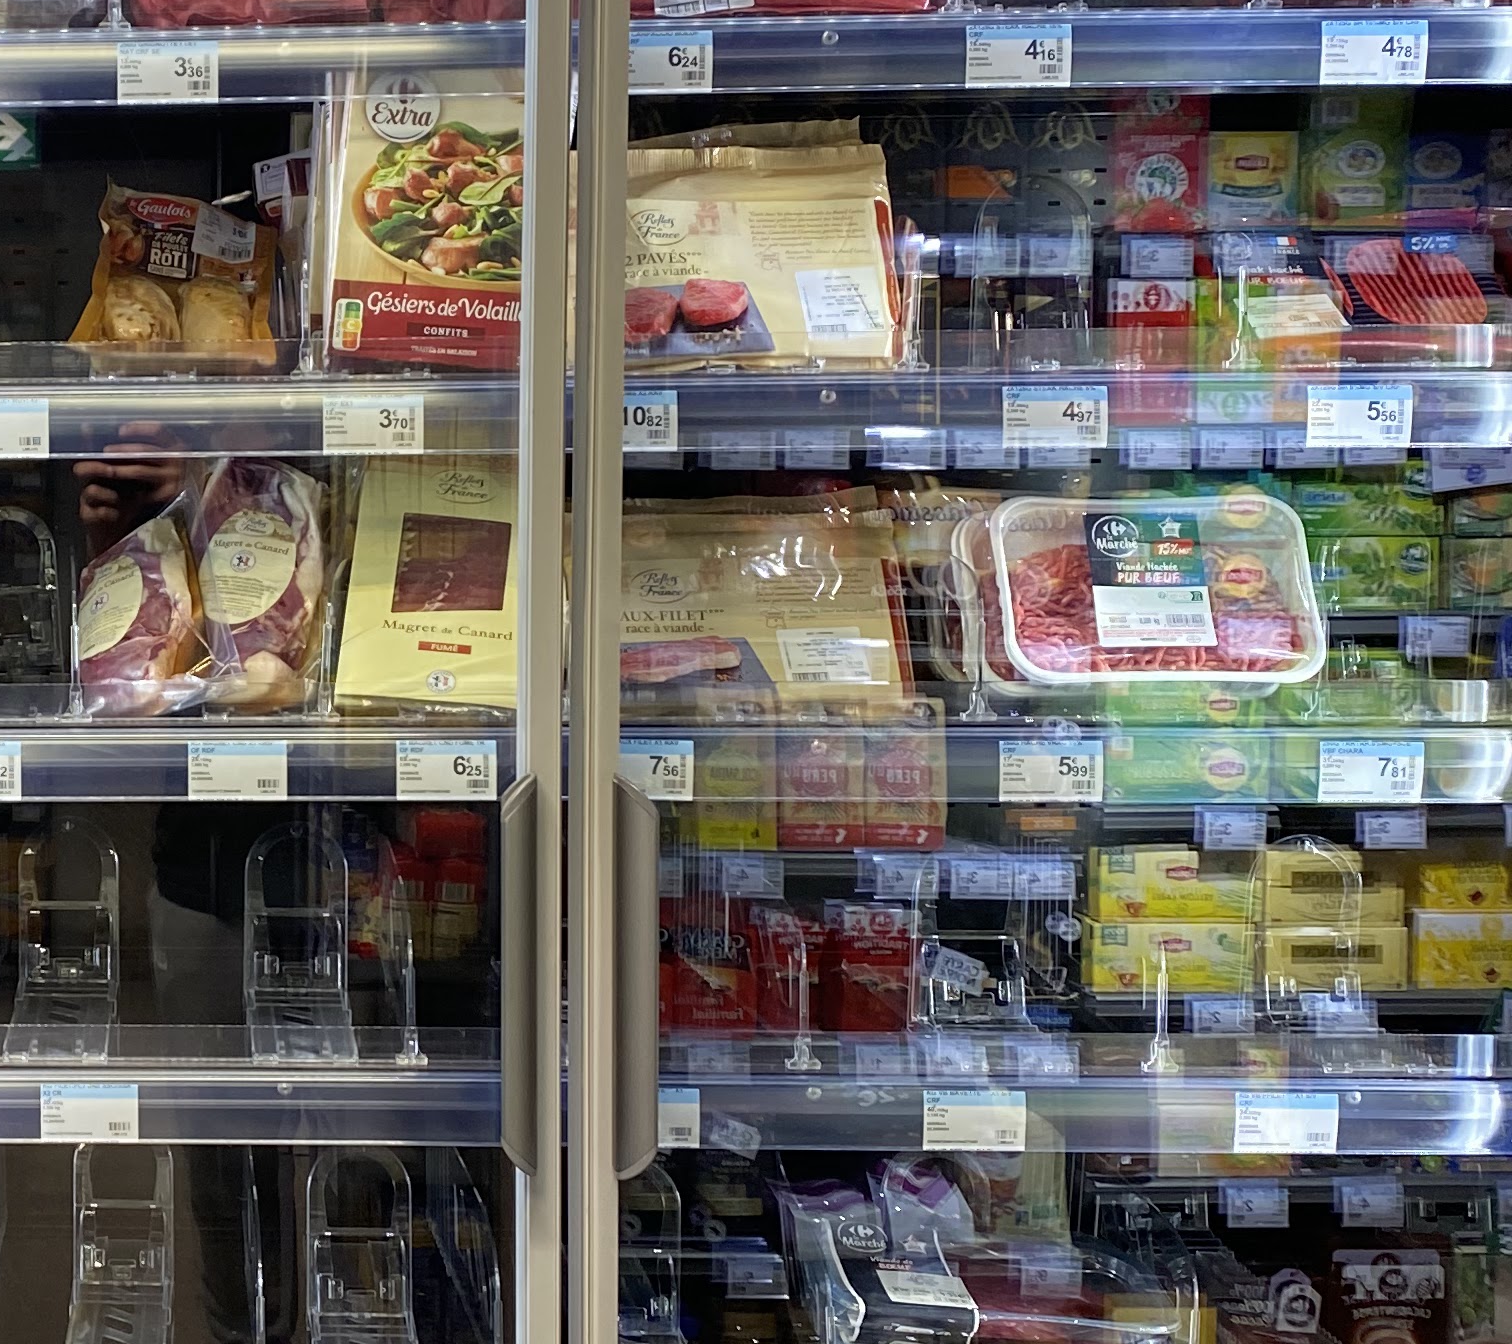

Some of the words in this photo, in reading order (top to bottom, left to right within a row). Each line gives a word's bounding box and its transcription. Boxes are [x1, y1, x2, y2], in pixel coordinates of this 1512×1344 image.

[371, 100, 434, 128] Extra
[137, 198, 192, 219] Gaulois
[1410, 236, 1435, 251] 5%
[149, 248, 188, 269] RÔTI
[624, 254, 634, 267] 2
[652, 264, 660, 276] à
[661, 264, 701, 277] viande
[1267, 264, 1304, 274] haché
[366, 290, 436, 316] Gésiers
[437, 299, 458, 318] de
[423, 325, 469, 338] CONFITS
[212, 538, 243, 548] Magret
[254, 540, 291, 557] Canard
[1095, 536, 1139, 551] Marché
[1115, 561, 1147, 572] Viande
[1147, 561, 1180, 572] Hachée
[1116, 571, 1142, 585] PUR
[1143, 571, 1181, 585] BŒUF
[381, 619, 437, 635] Magret
[440, 626, 453, 635] de
[457, 625, 513, 641] Canard
[624, 623, 652, 633] race
[653, 621, 662, 633] à
[663, 620, 705, 634] viande
[429, 642, 459, 653] FUMÉ
[841, 1235, 887, 1251] Marché
